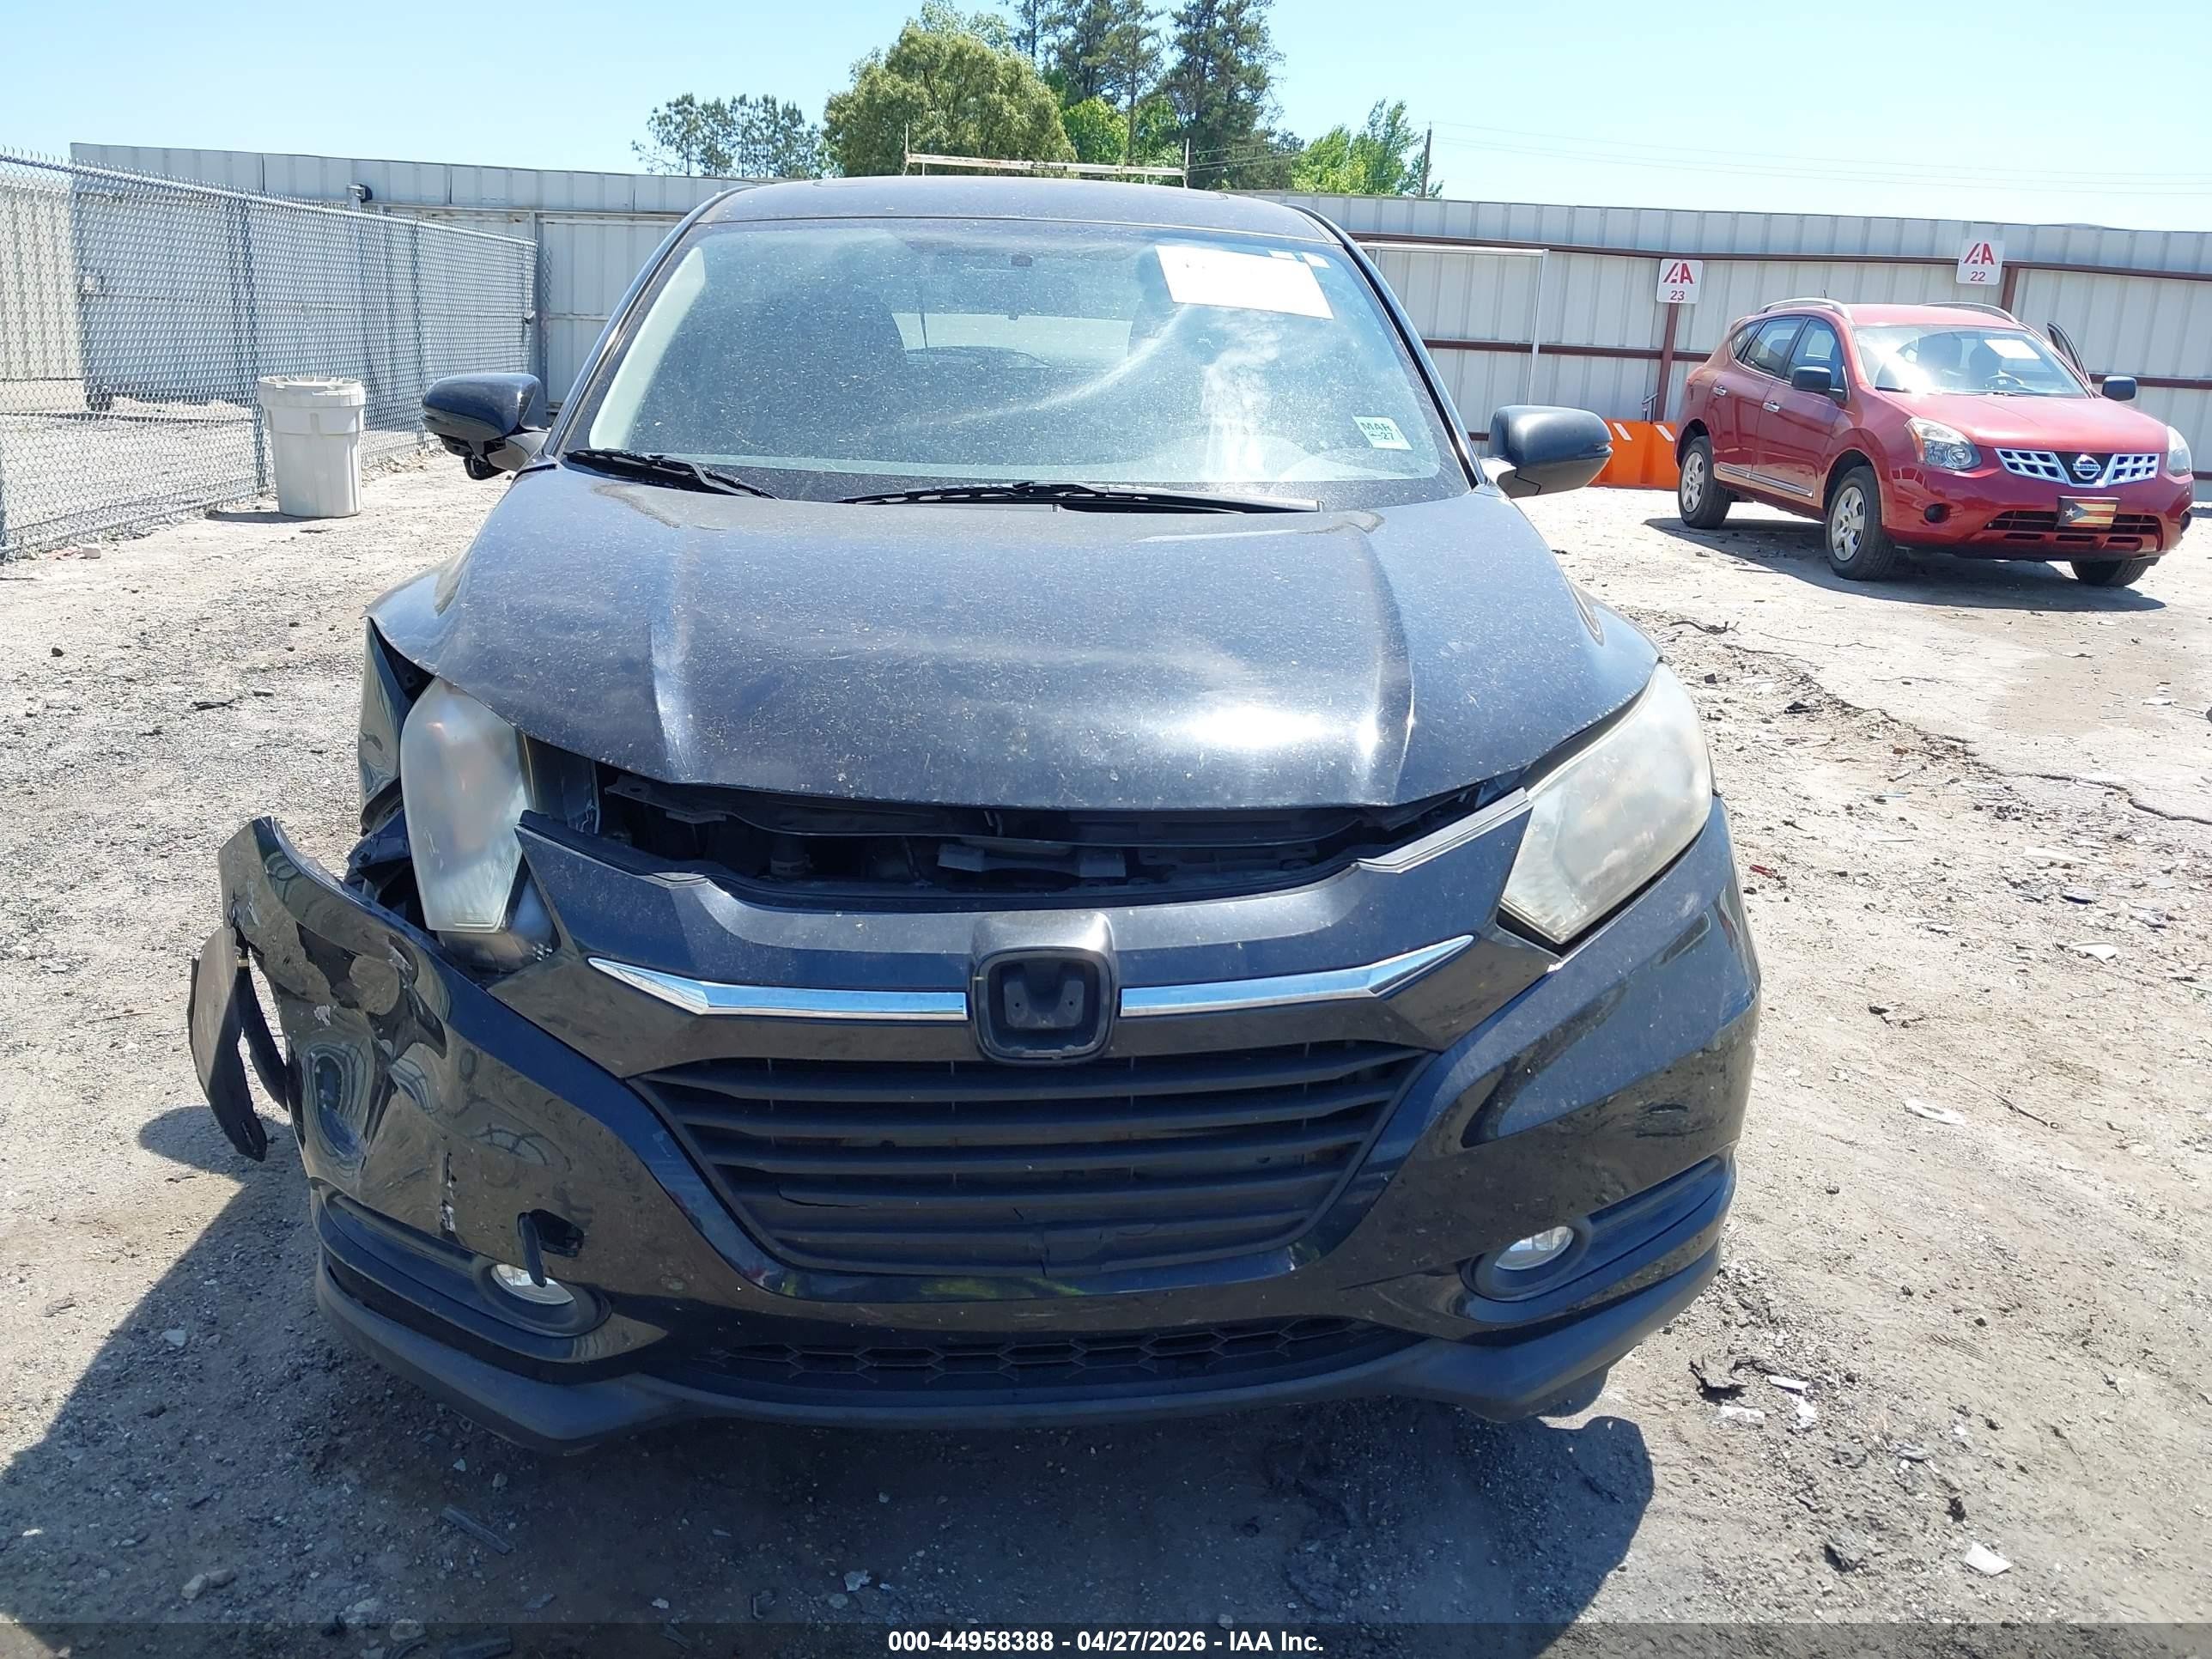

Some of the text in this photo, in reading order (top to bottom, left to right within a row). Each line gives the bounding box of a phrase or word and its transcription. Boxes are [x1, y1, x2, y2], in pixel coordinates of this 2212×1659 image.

[1970, 270, 1986, 282] 22
[1669, 290, 1685, 301] 23
[1359, 422, 1393, 432] MAR
[1380, 432, 1395, 441] 27
